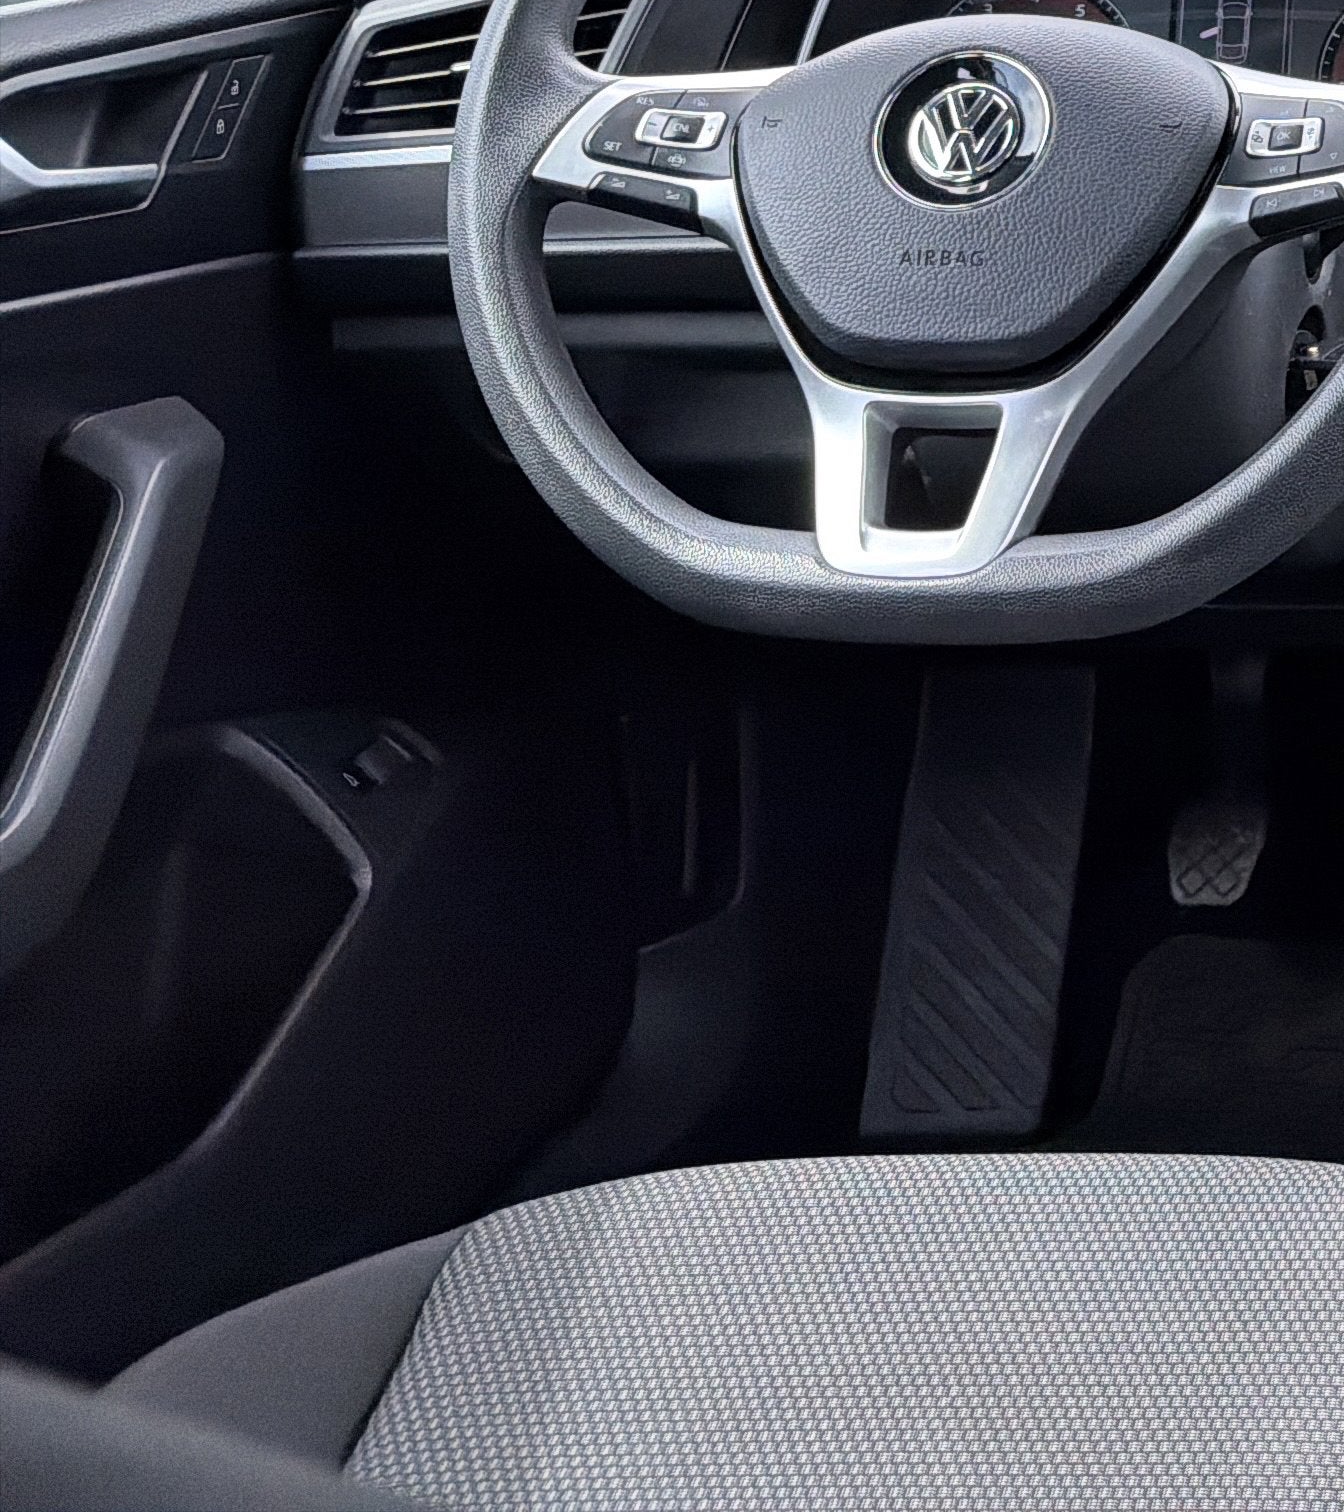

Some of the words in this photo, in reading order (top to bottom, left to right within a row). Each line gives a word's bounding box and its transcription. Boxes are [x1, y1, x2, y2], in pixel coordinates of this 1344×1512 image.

[1074, 4, 1086, 18] 5
[635, 96, 655, 106] RES
[602, 140, 623, 152] SET
[901, 249, 985, 267] AIRBAG
